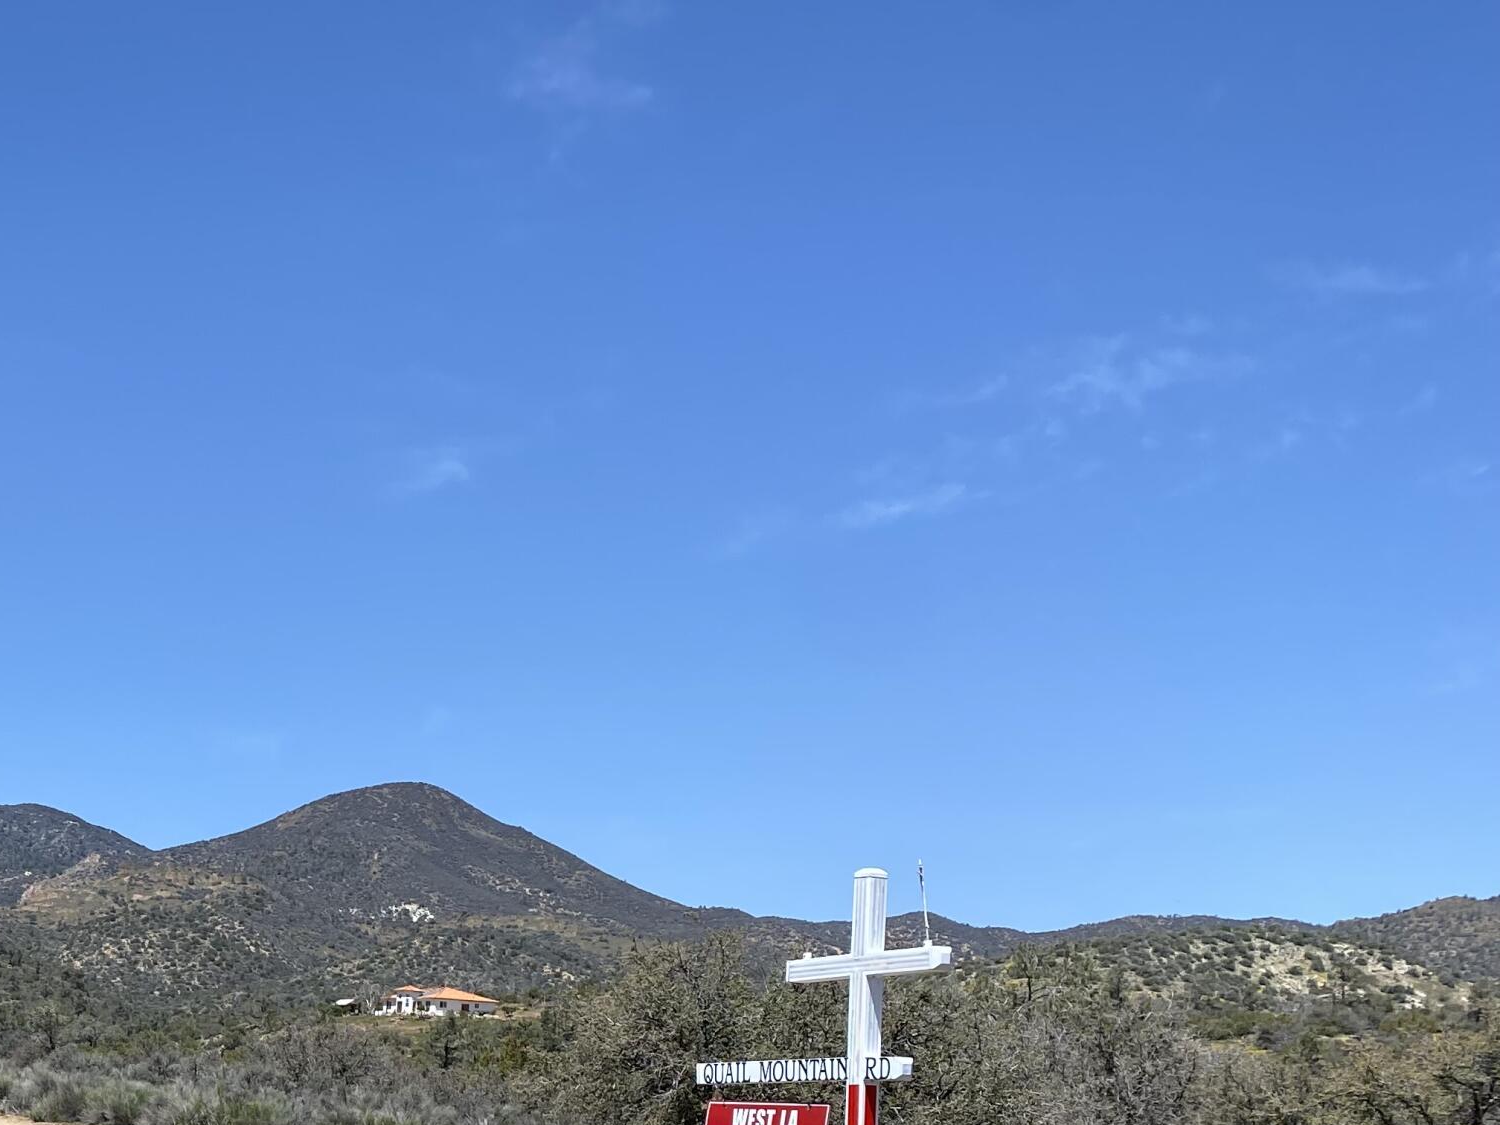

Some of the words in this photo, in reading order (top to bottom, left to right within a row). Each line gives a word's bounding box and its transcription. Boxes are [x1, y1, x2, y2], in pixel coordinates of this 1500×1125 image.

[703, 1062, 751, 1084] QUAIL
[760, 1057, 848, 1083] MOUNTAIN
[865, 1057, 891, 1080] RD
